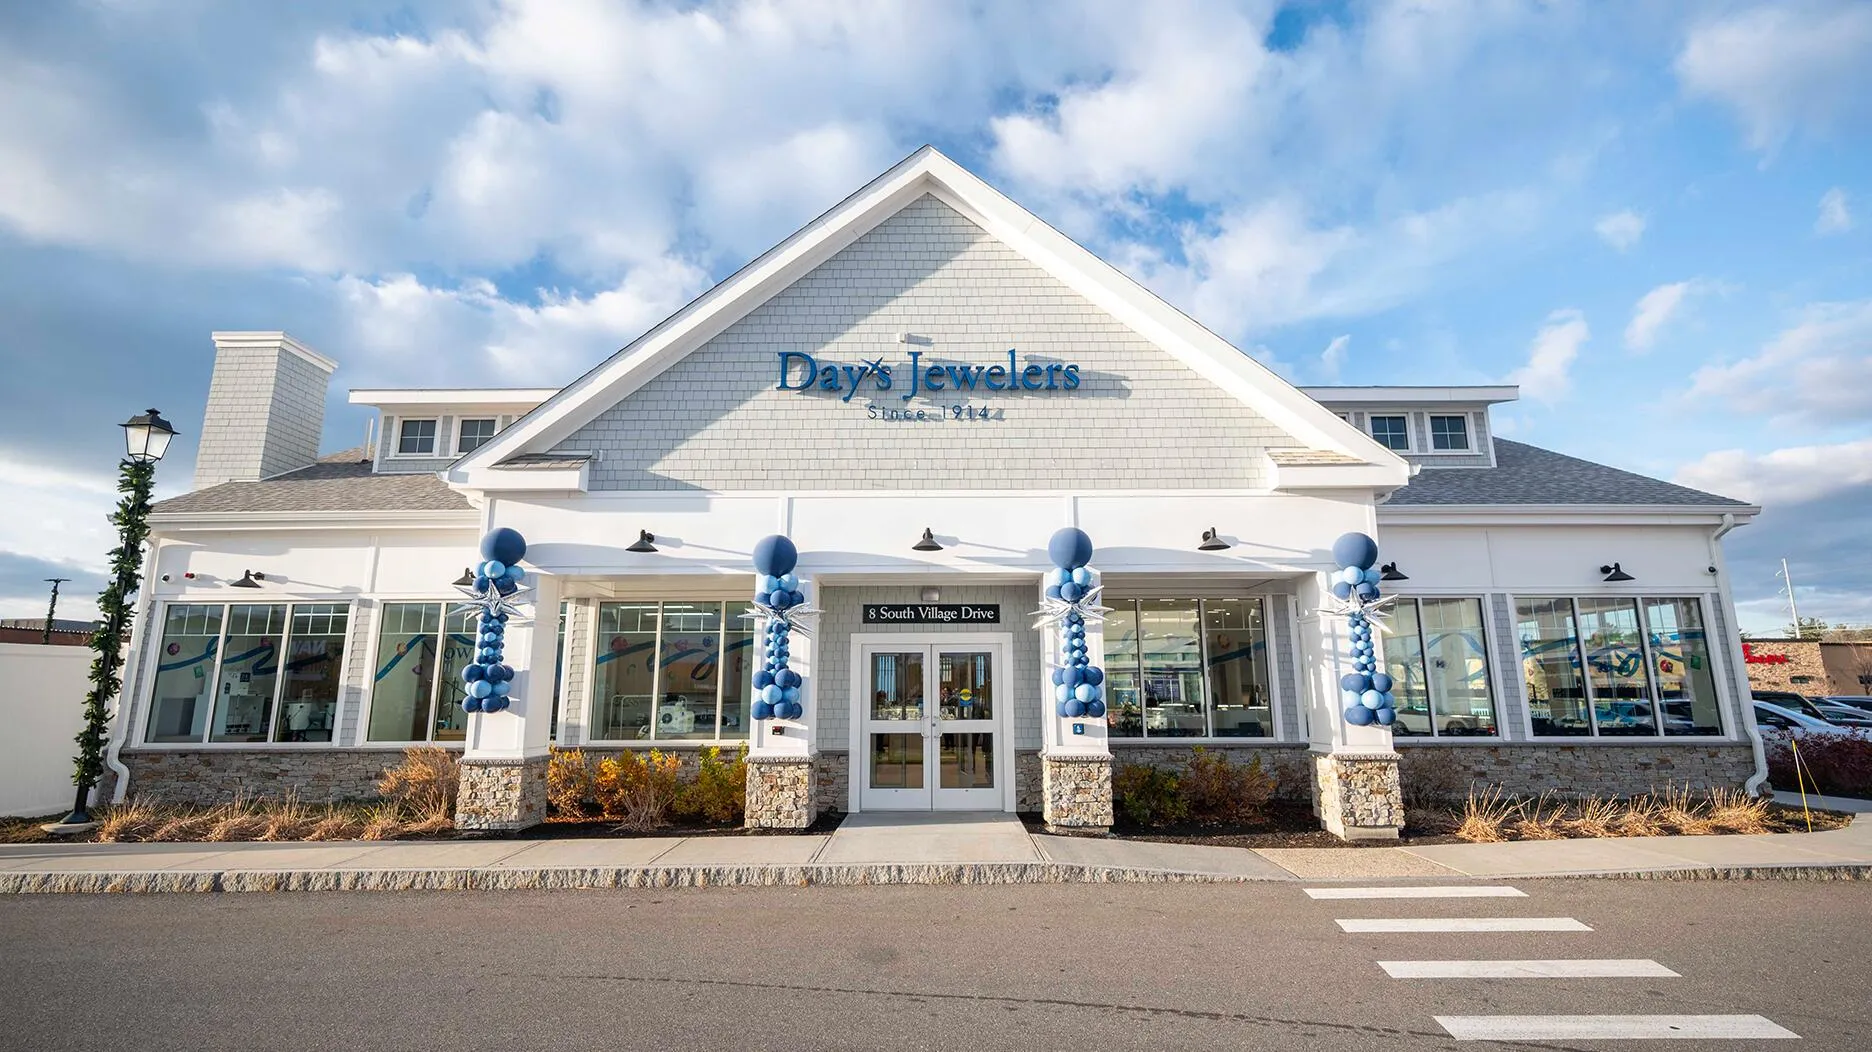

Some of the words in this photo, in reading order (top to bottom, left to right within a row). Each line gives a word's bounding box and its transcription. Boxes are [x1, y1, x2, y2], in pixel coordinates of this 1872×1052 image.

[902, 348, 1080, 401] Jewelers
[868, 405, 925, 420] Since
[941, 405, 989, 419] 1914
[868, 608, 876, 619] 8
[880, 606, 915, 619] South
[918, 606, 958, 621] Village
[961, 606, 994, 619] Drive
